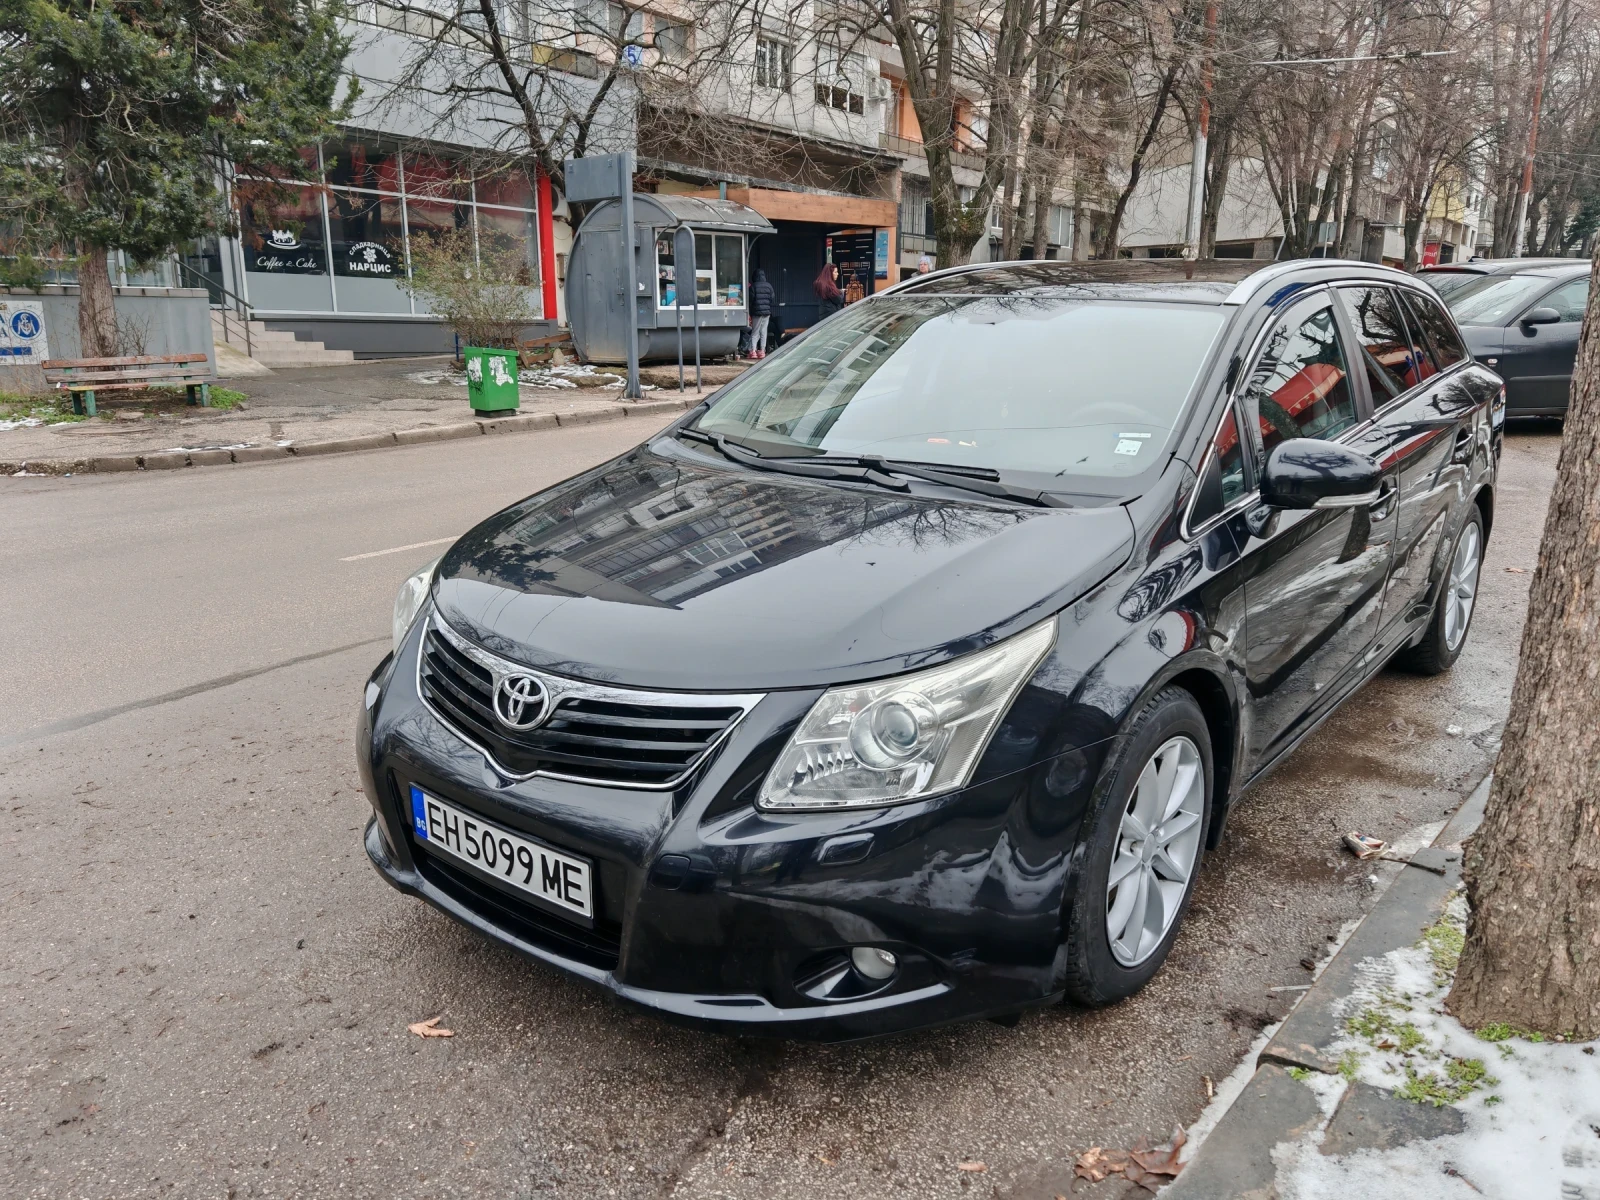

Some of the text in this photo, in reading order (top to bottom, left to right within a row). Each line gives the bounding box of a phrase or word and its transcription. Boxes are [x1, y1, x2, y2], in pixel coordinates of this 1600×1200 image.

[257, 256, 284, 270] Coffee
[295, 257, 318, 269] Cake
[349, 261, 391, 274] НАРЦИС
[416, 816, 427, 831] BG
